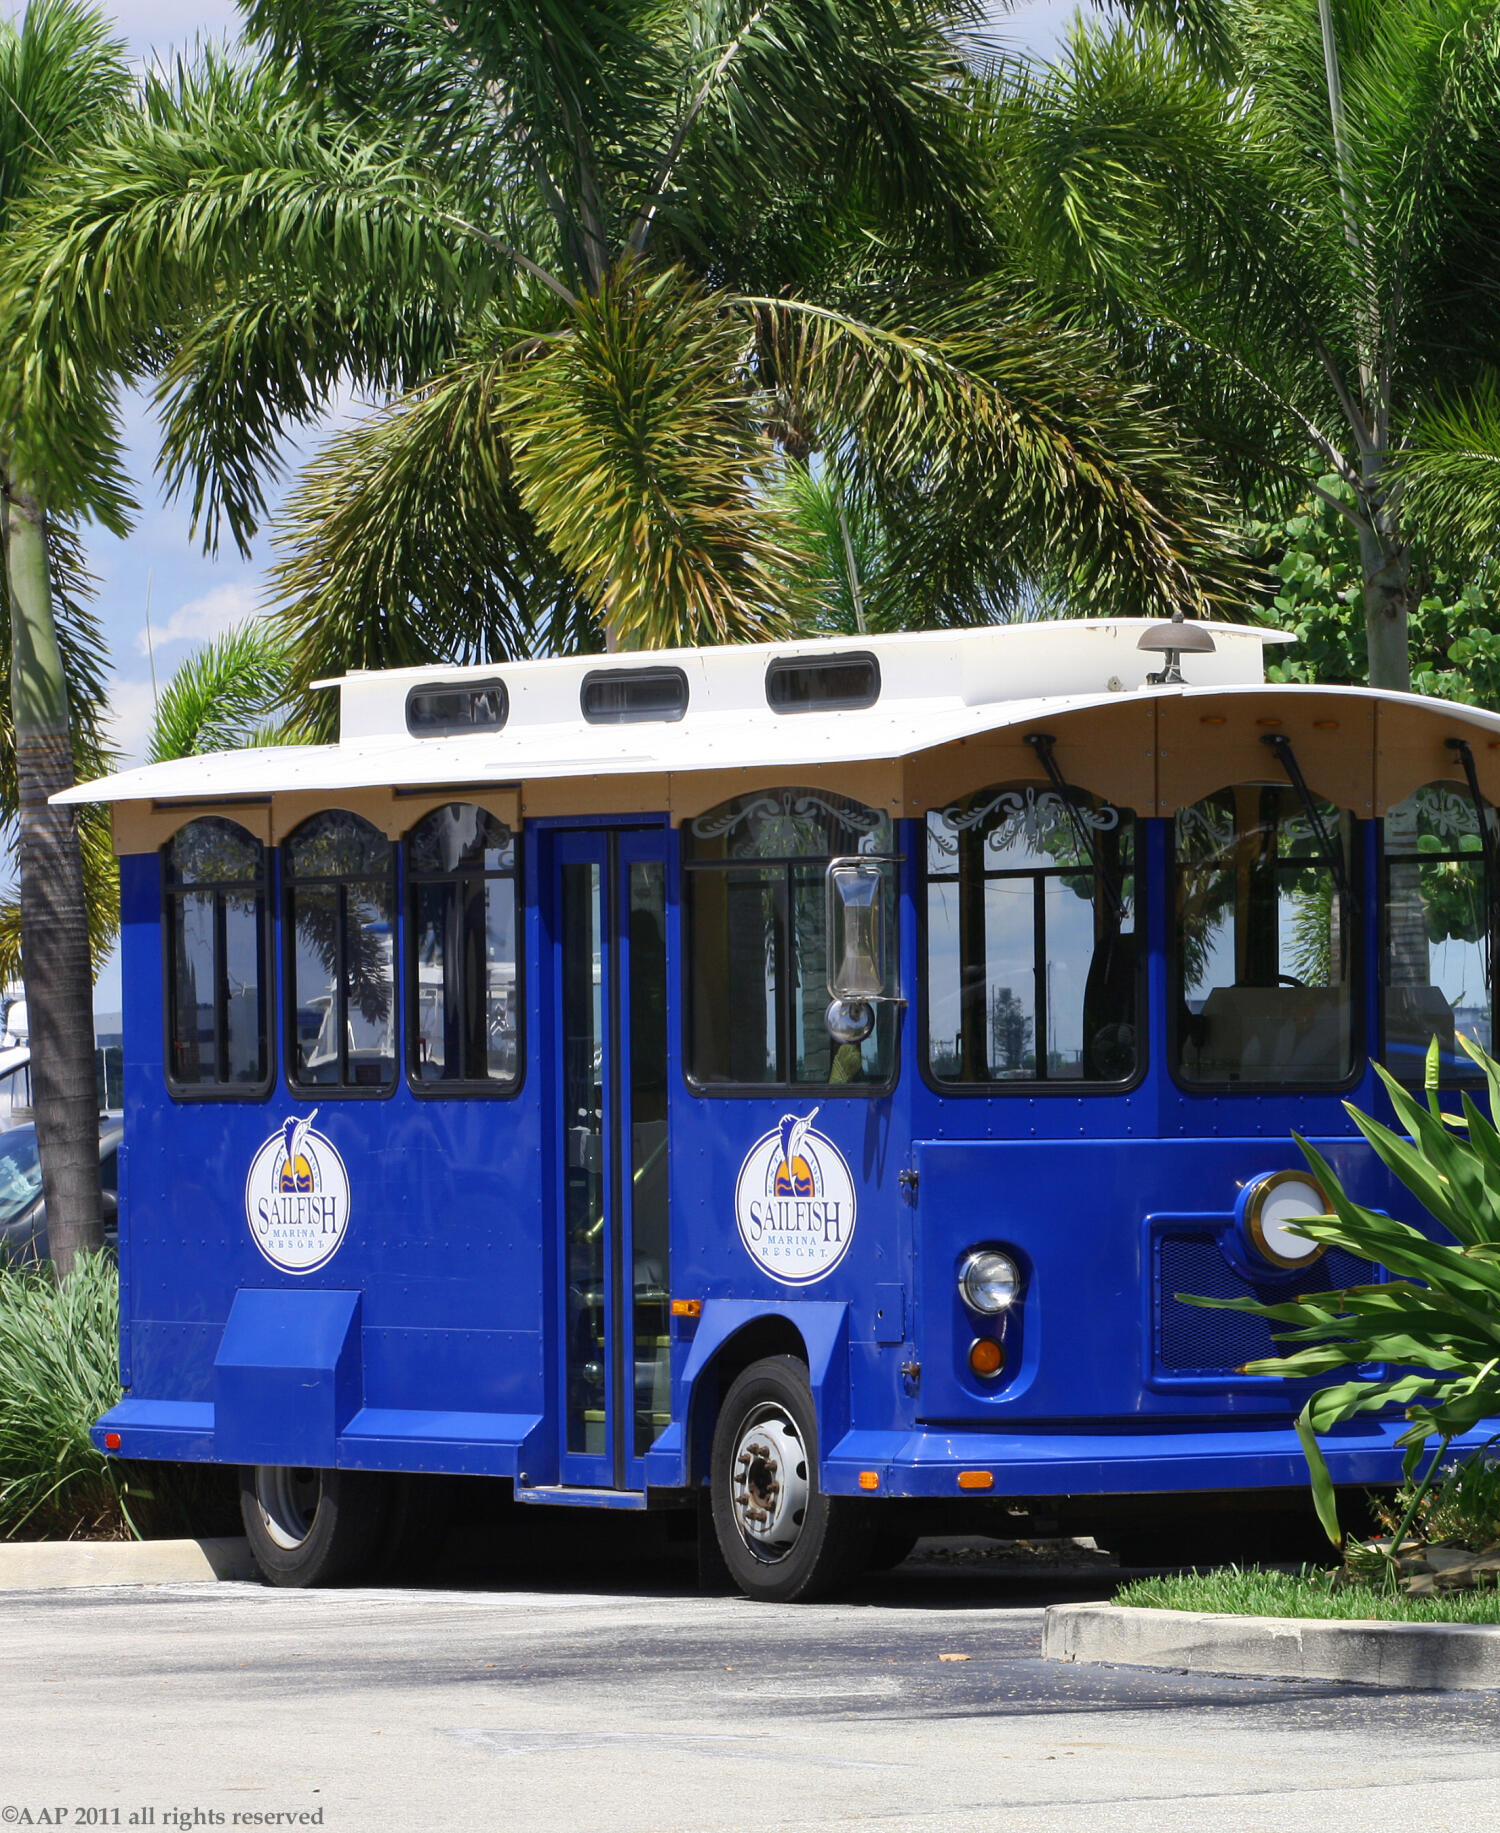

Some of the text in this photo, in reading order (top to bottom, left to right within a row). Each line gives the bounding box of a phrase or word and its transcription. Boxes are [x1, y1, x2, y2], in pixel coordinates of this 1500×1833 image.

[258, 1196, 338, 1235] SAILFISH
[750, 1200, 842, 1242] SAILFISH
[273, 1229, 315, 1238] MARINA
[268, 1239, 325, 1249] RESORT
[768, 1235, 816, 1246] MARINA
[762, 1247, 828, 1258] RESORT
